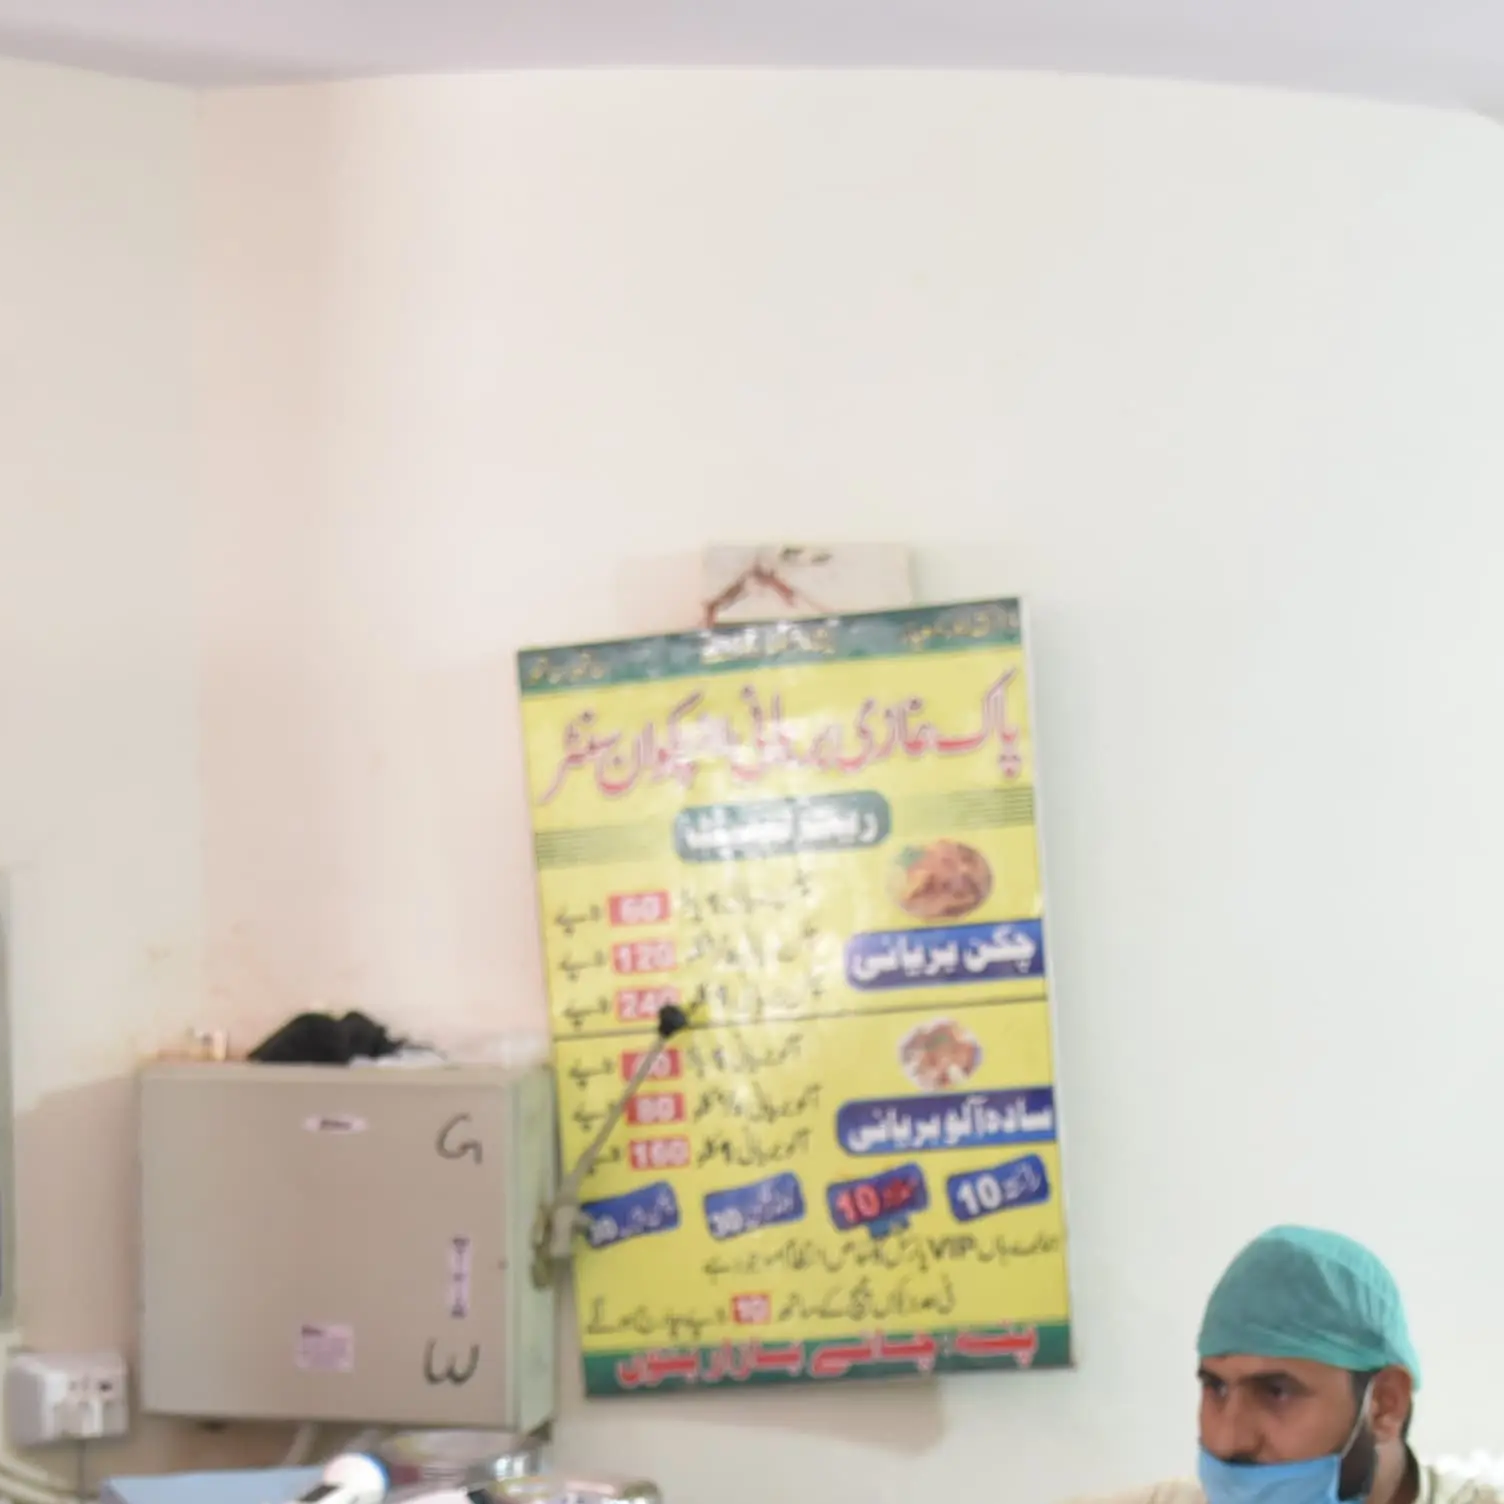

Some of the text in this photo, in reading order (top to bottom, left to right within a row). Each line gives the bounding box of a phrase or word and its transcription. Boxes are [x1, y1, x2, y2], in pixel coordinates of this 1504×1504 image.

[851, 940, 957, 983] بریانی
[962, 929, 1037, 972] چکن
[434, 1111, 484, 1166] G
[848, 1107, 941, 1152] بریانی
[835, 1183, 882, 1223] 10
[957, 1181, 1002, 1216] 10
[927, 1232, 979, 1260] VIP
